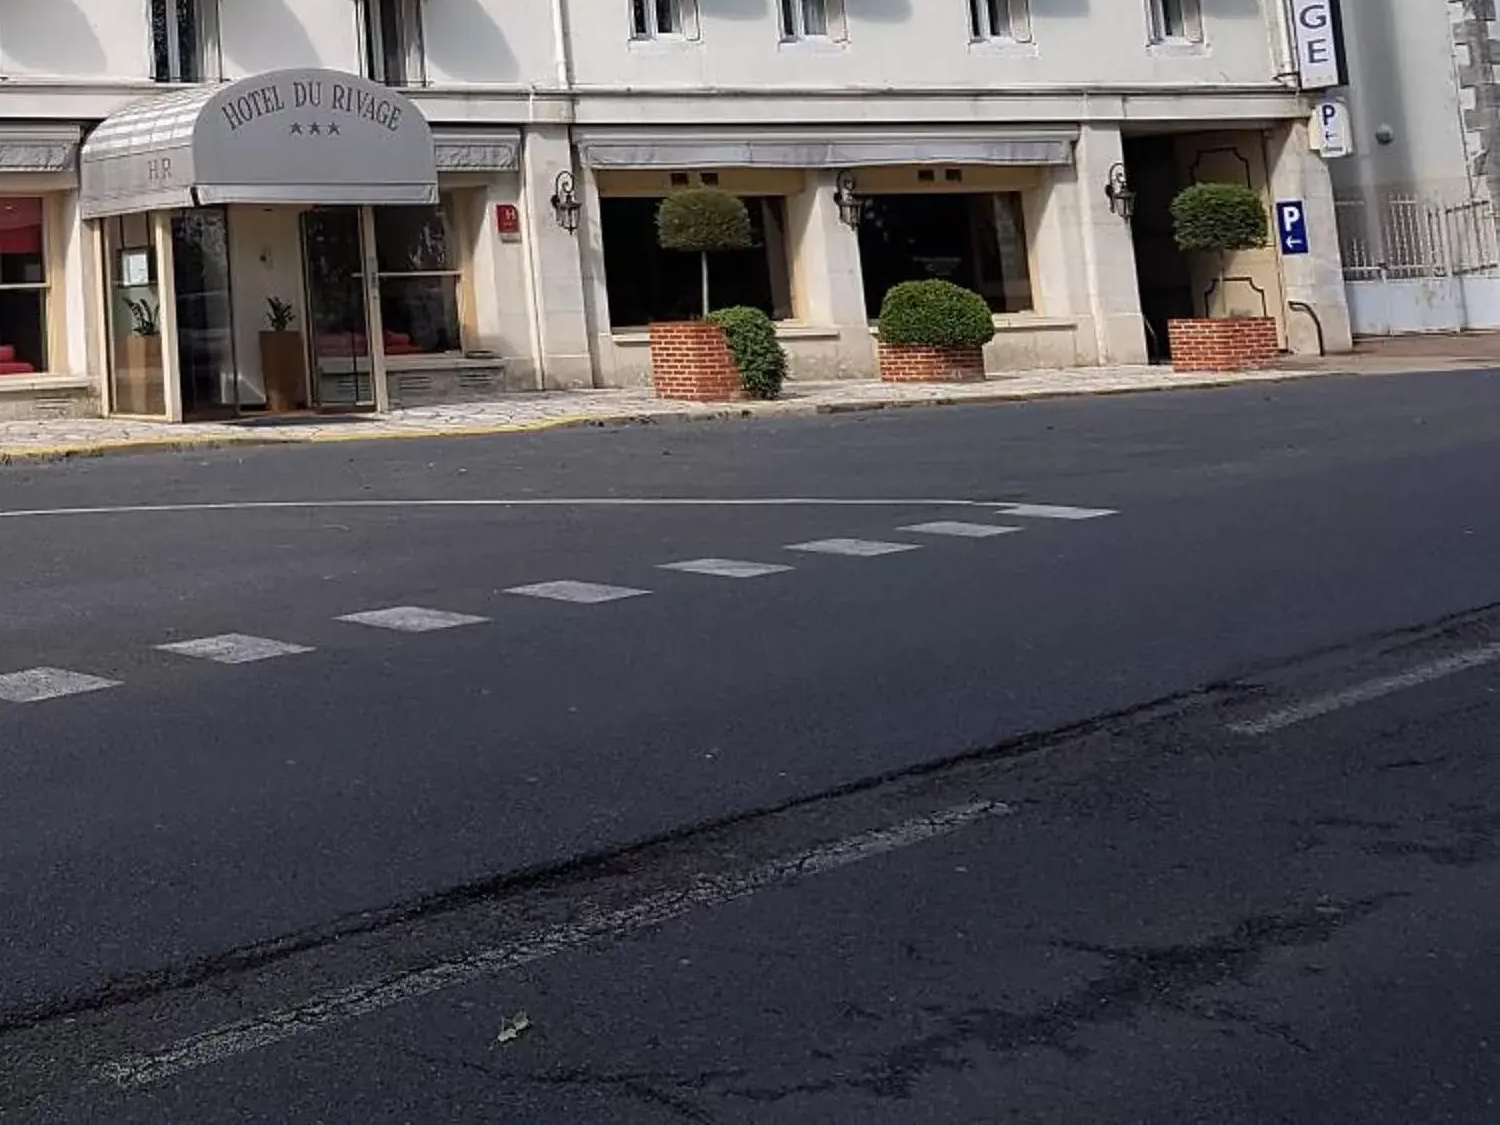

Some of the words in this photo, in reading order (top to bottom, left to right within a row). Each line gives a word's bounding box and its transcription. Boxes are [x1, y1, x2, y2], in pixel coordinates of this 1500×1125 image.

[221, 85, 285, 132] HOTEL
[293, 81, 322, 108] DU
[332, 83, 402, 132] RIVAGE
[1322, 104, 1336, 126] P
[1283, 206, 1300, 232] P
